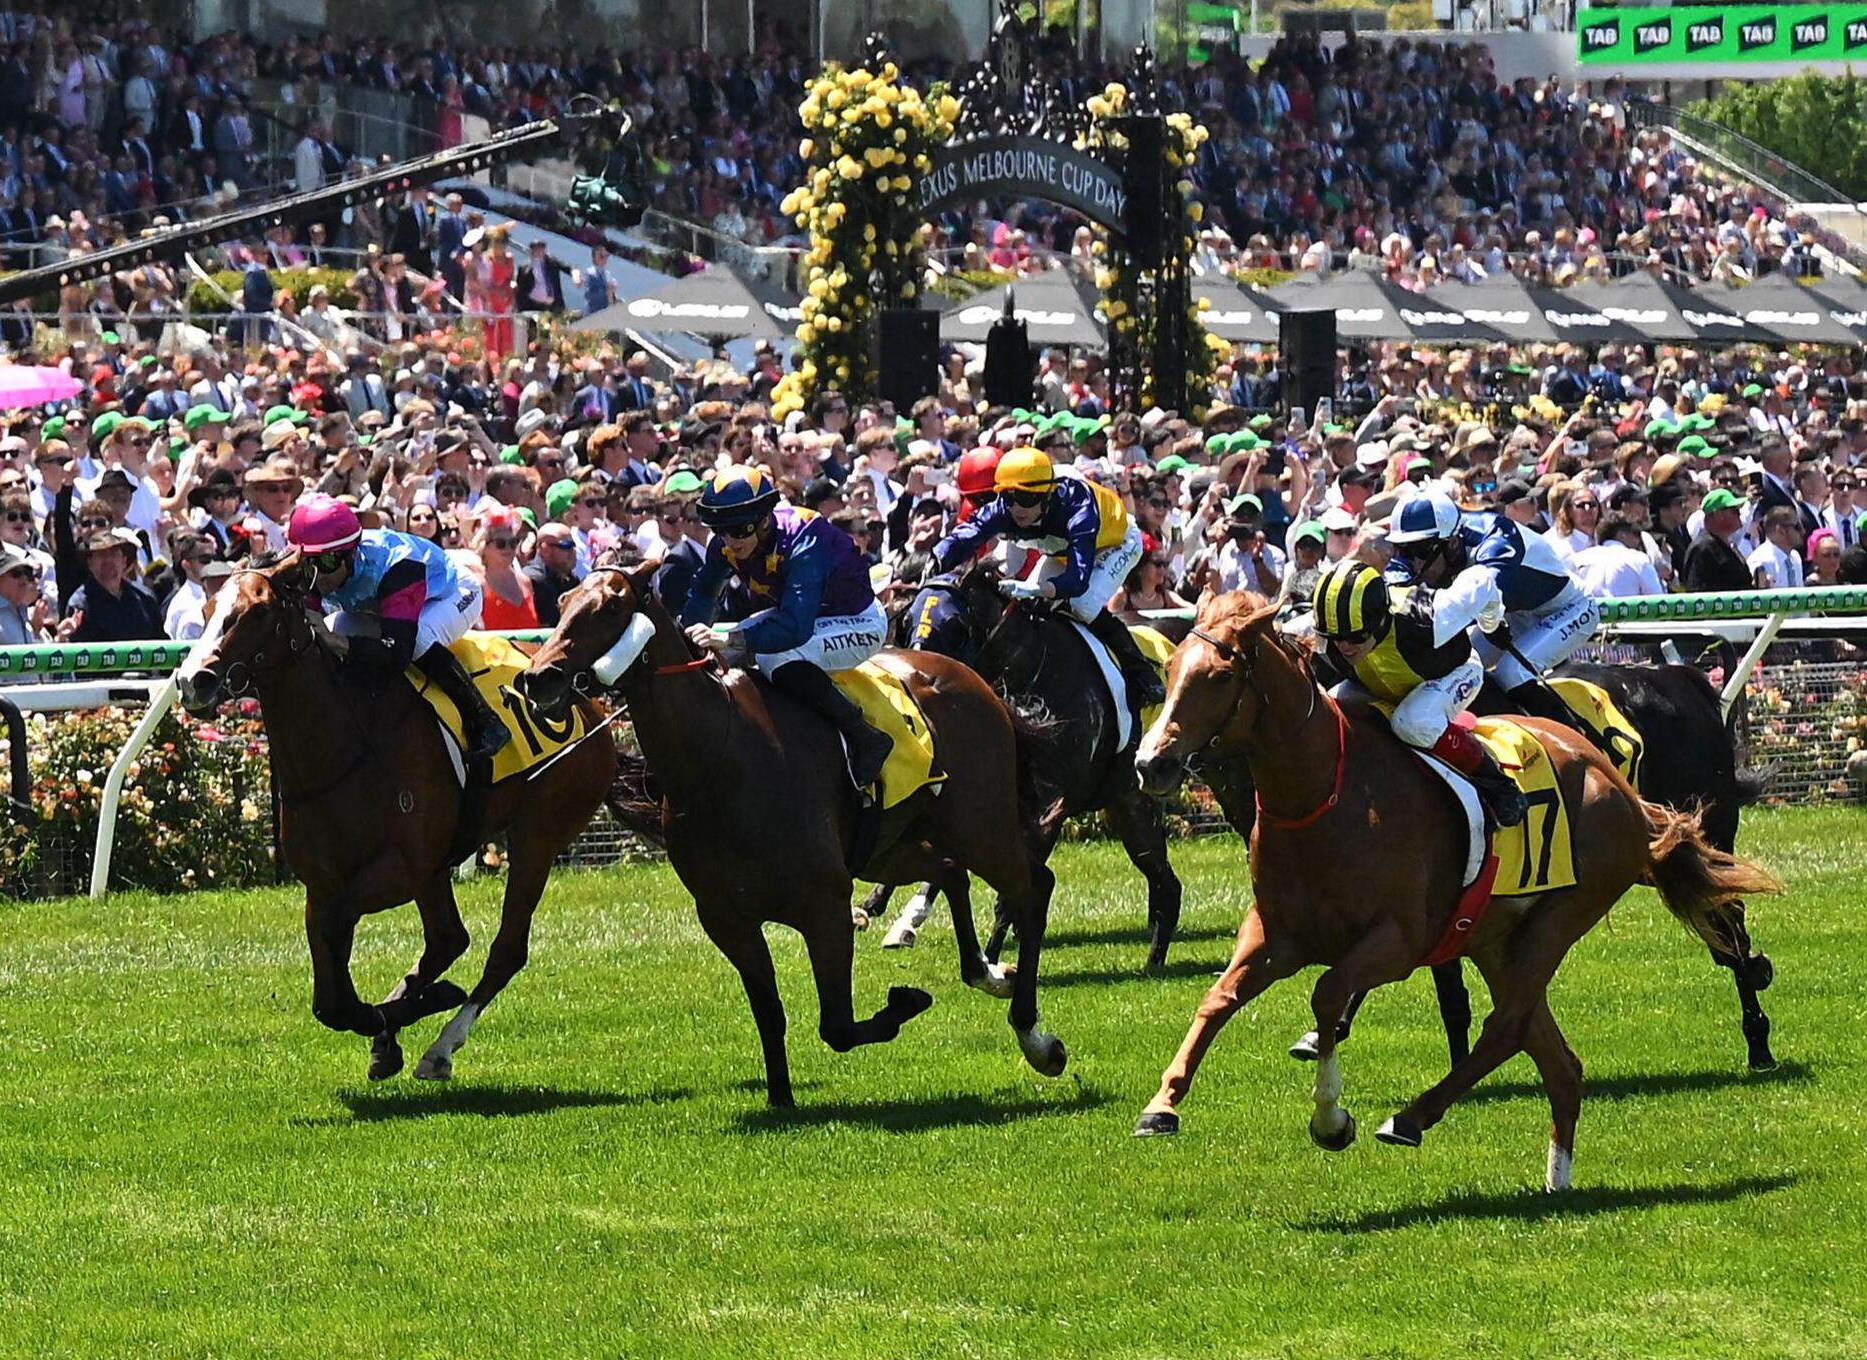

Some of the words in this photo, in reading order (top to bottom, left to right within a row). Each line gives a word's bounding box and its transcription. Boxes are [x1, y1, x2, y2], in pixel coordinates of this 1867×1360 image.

[1586, 27, 1617, 44] TAB
[1638, 27, 1670, 44] TAB
[1690, 26, 1721, 43] TAB
[1743, 25, 1773, 42] TAB
[1796, 25, 1826, 42] TAB
[1848, 24, 1867, 41] TA
[919, 162, 957, 209] EXUS
[964, 150, 1057, 186] MELBOURNE
[1062, 160, 1092, 198] CUP
[1094, 178, 1127, 217] DAY
[823, 632, 880, 652] AITKEN
[1519, 788, 1560, 888] 17
